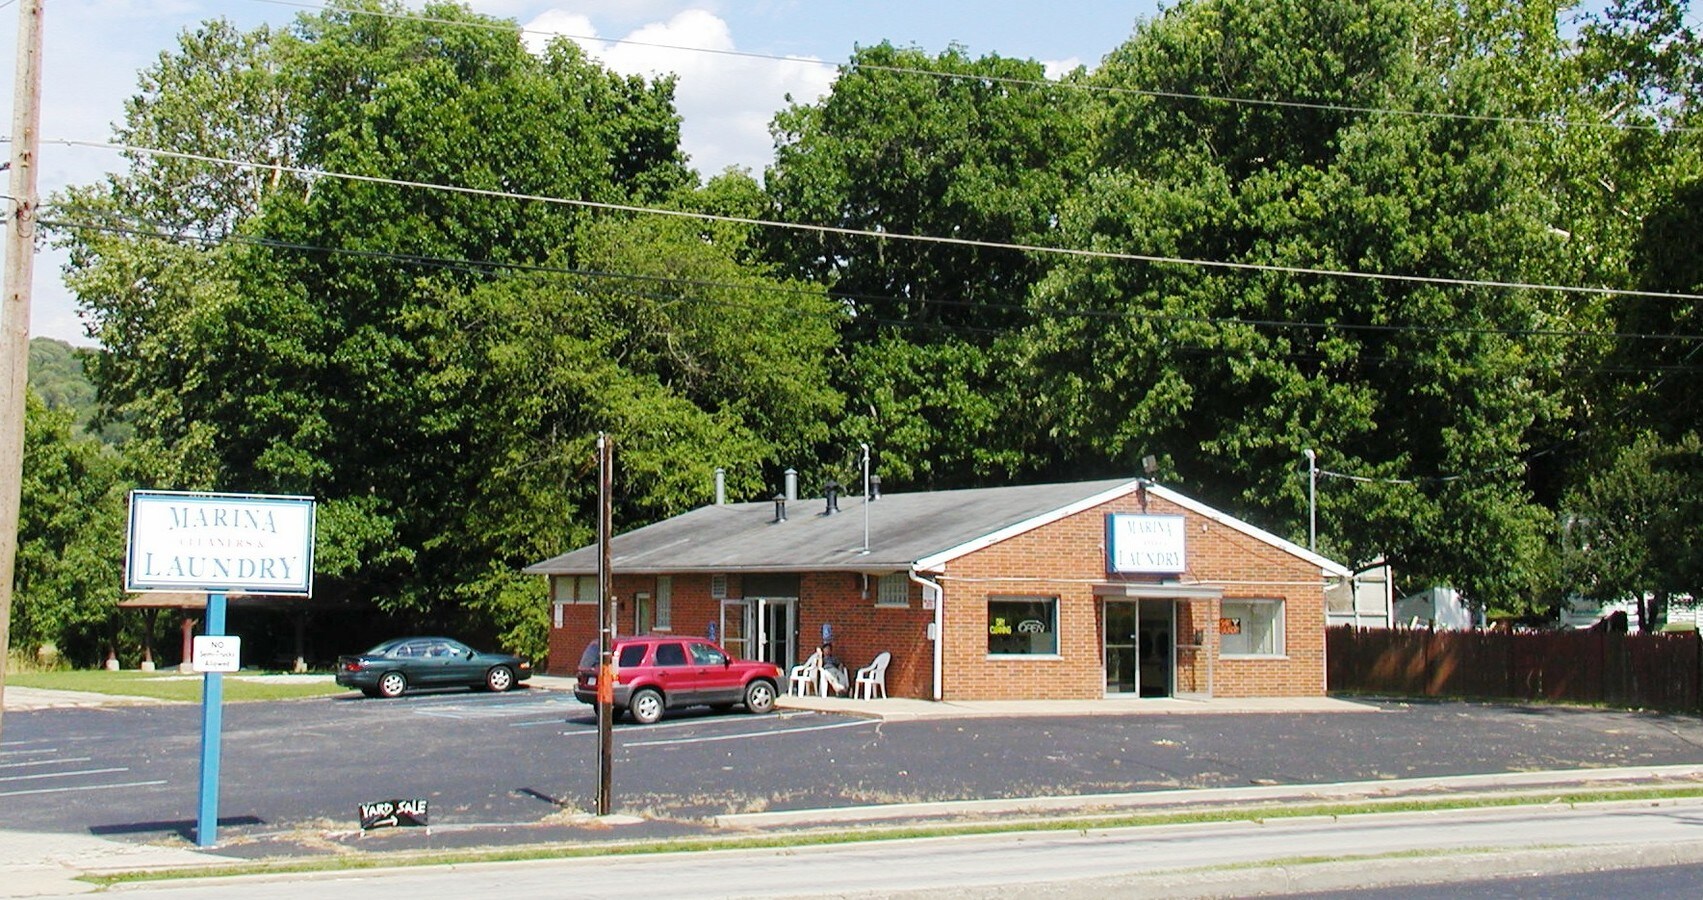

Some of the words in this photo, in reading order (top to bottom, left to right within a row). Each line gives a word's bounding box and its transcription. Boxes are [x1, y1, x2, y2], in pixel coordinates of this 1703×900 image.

[169, 507, 277, 533] MARINA
[1125, 520, 1172, 536] MARINA
[145, 552, 297, 579] LAUNDRY
[1118, 550, 1180, 566] LAUNDRY
[1018, 621, 1046, 633] OPEN
[211, 641, 225, 649] NO
[361, 802, 394, 819] YARD
[396, 799, 427, 815] SALE
